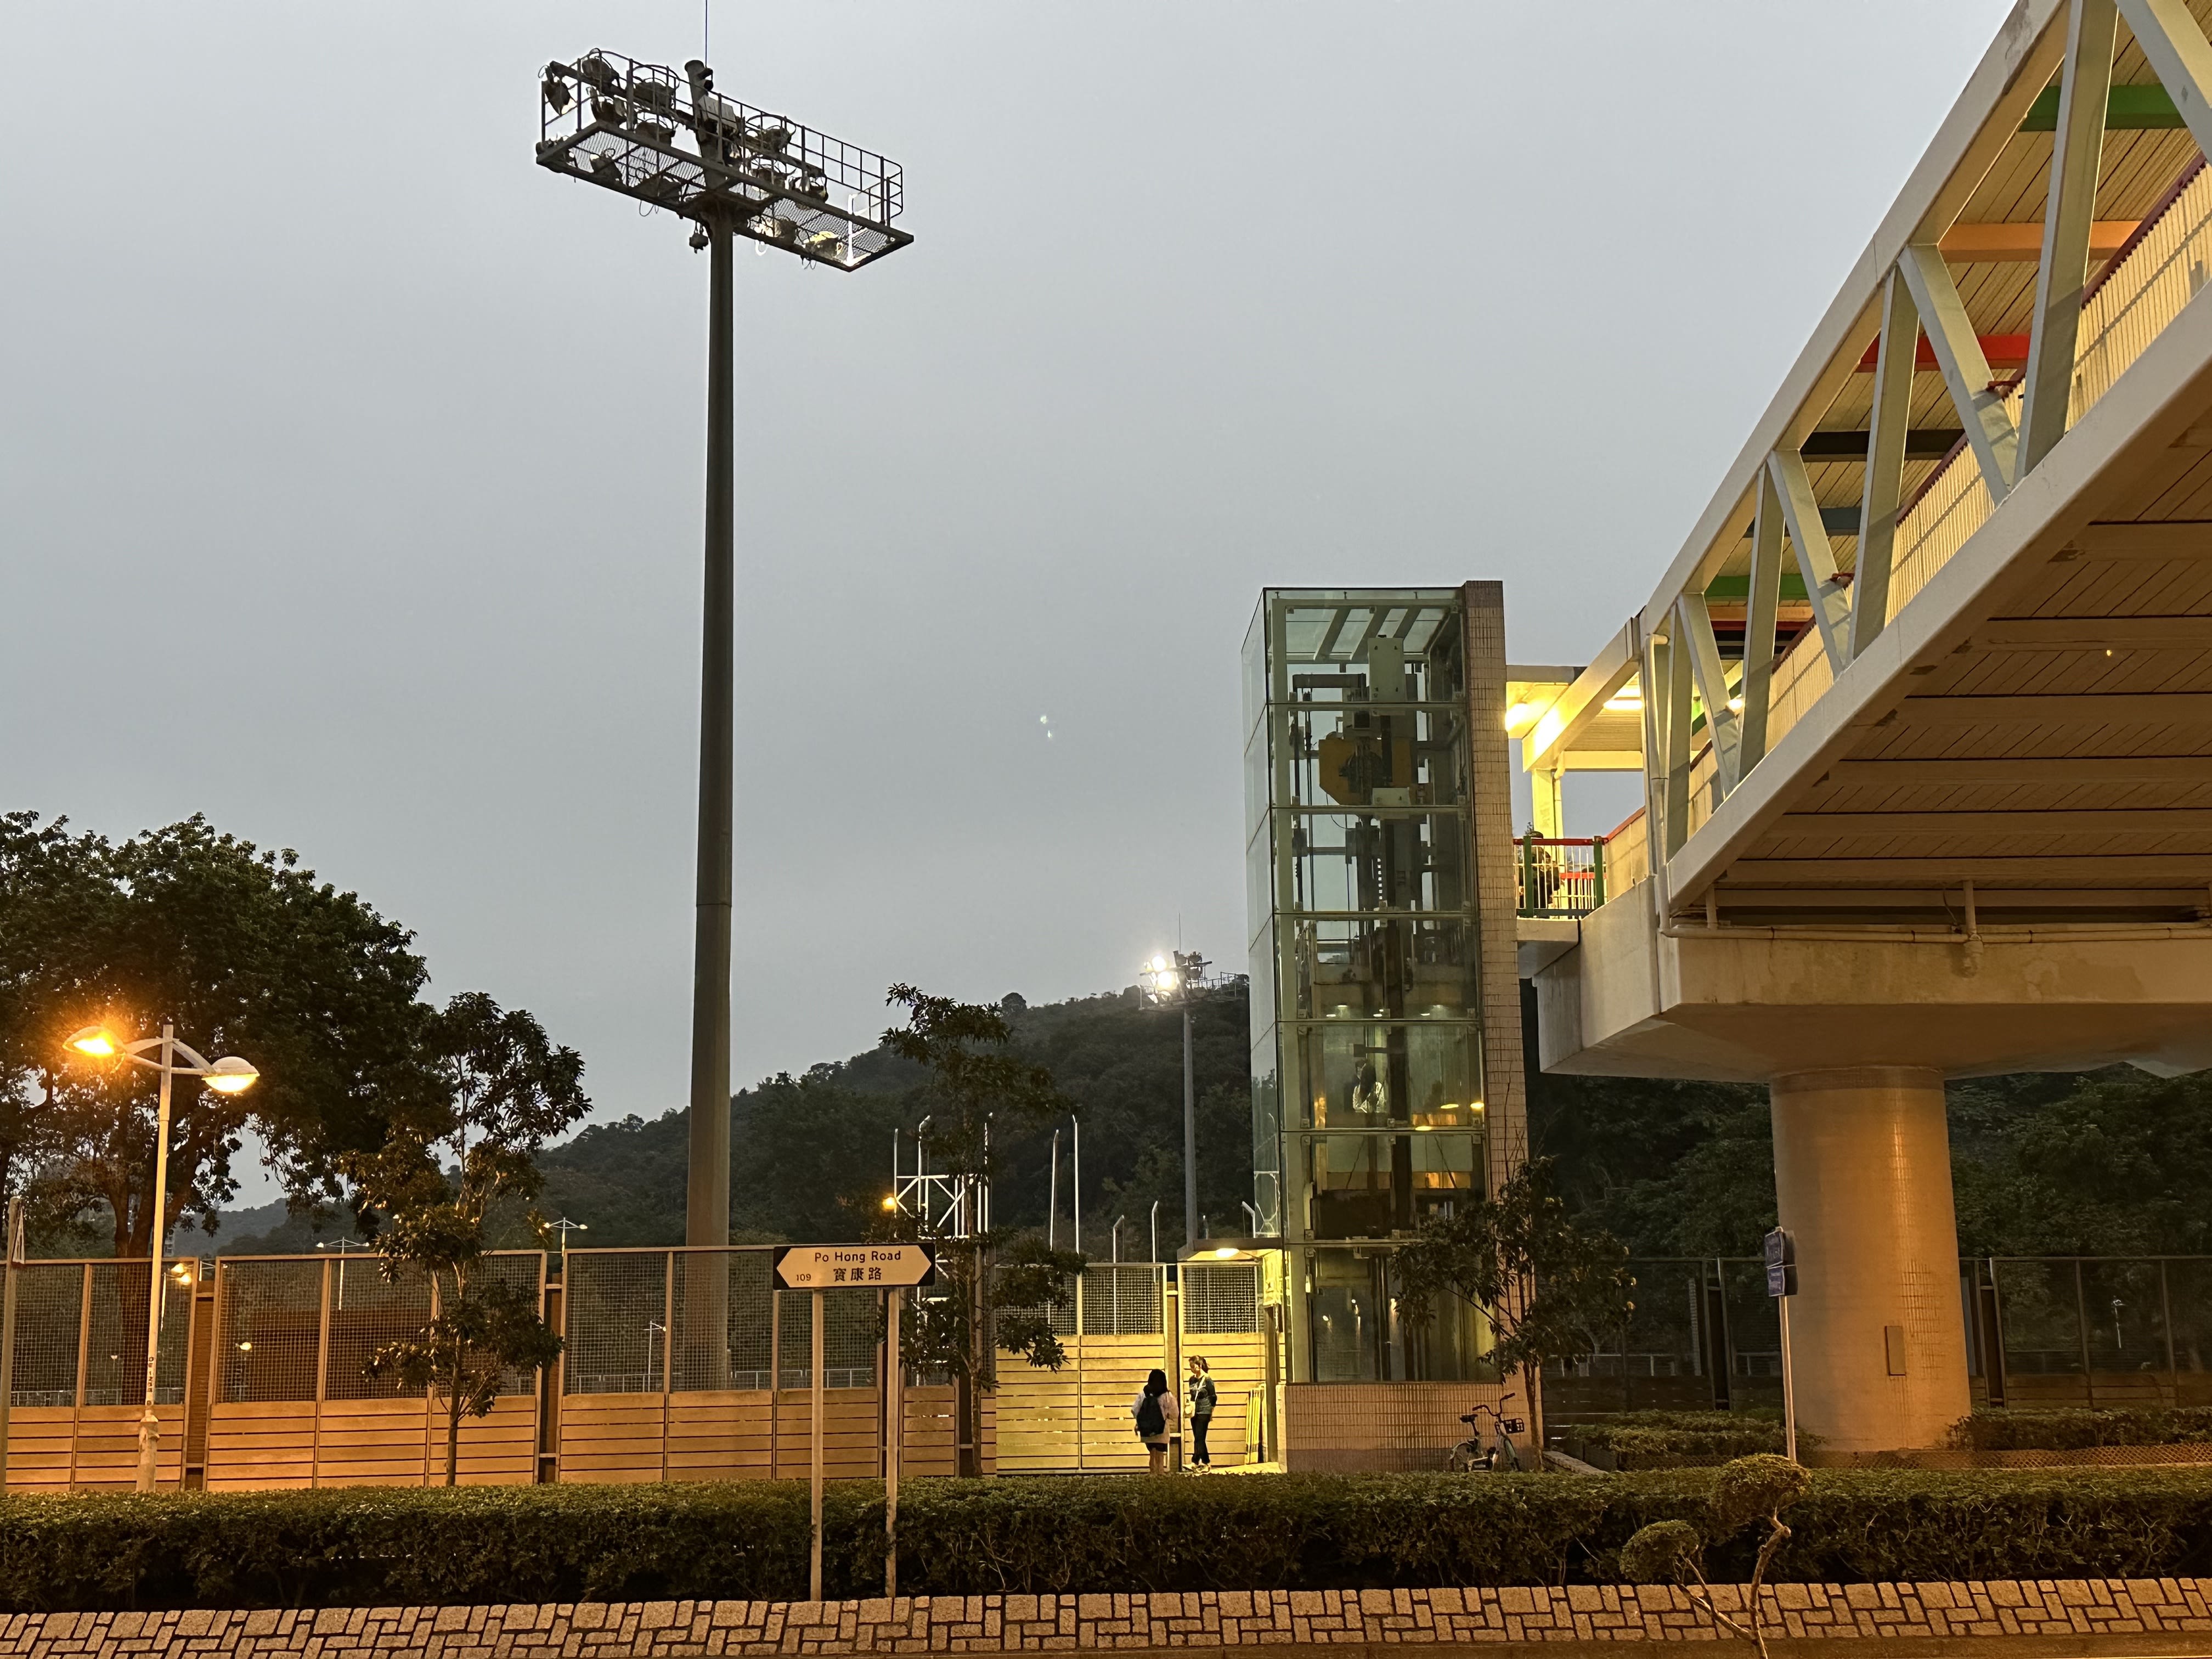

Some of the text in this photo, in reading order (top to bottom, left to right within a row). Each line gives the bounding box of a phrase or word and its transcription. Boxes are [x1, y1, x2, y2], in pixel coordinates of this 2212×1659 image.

[815, 1251, 901, 1263] Po Hong Road
[833, 1267, 882, 1282] 寶康路
